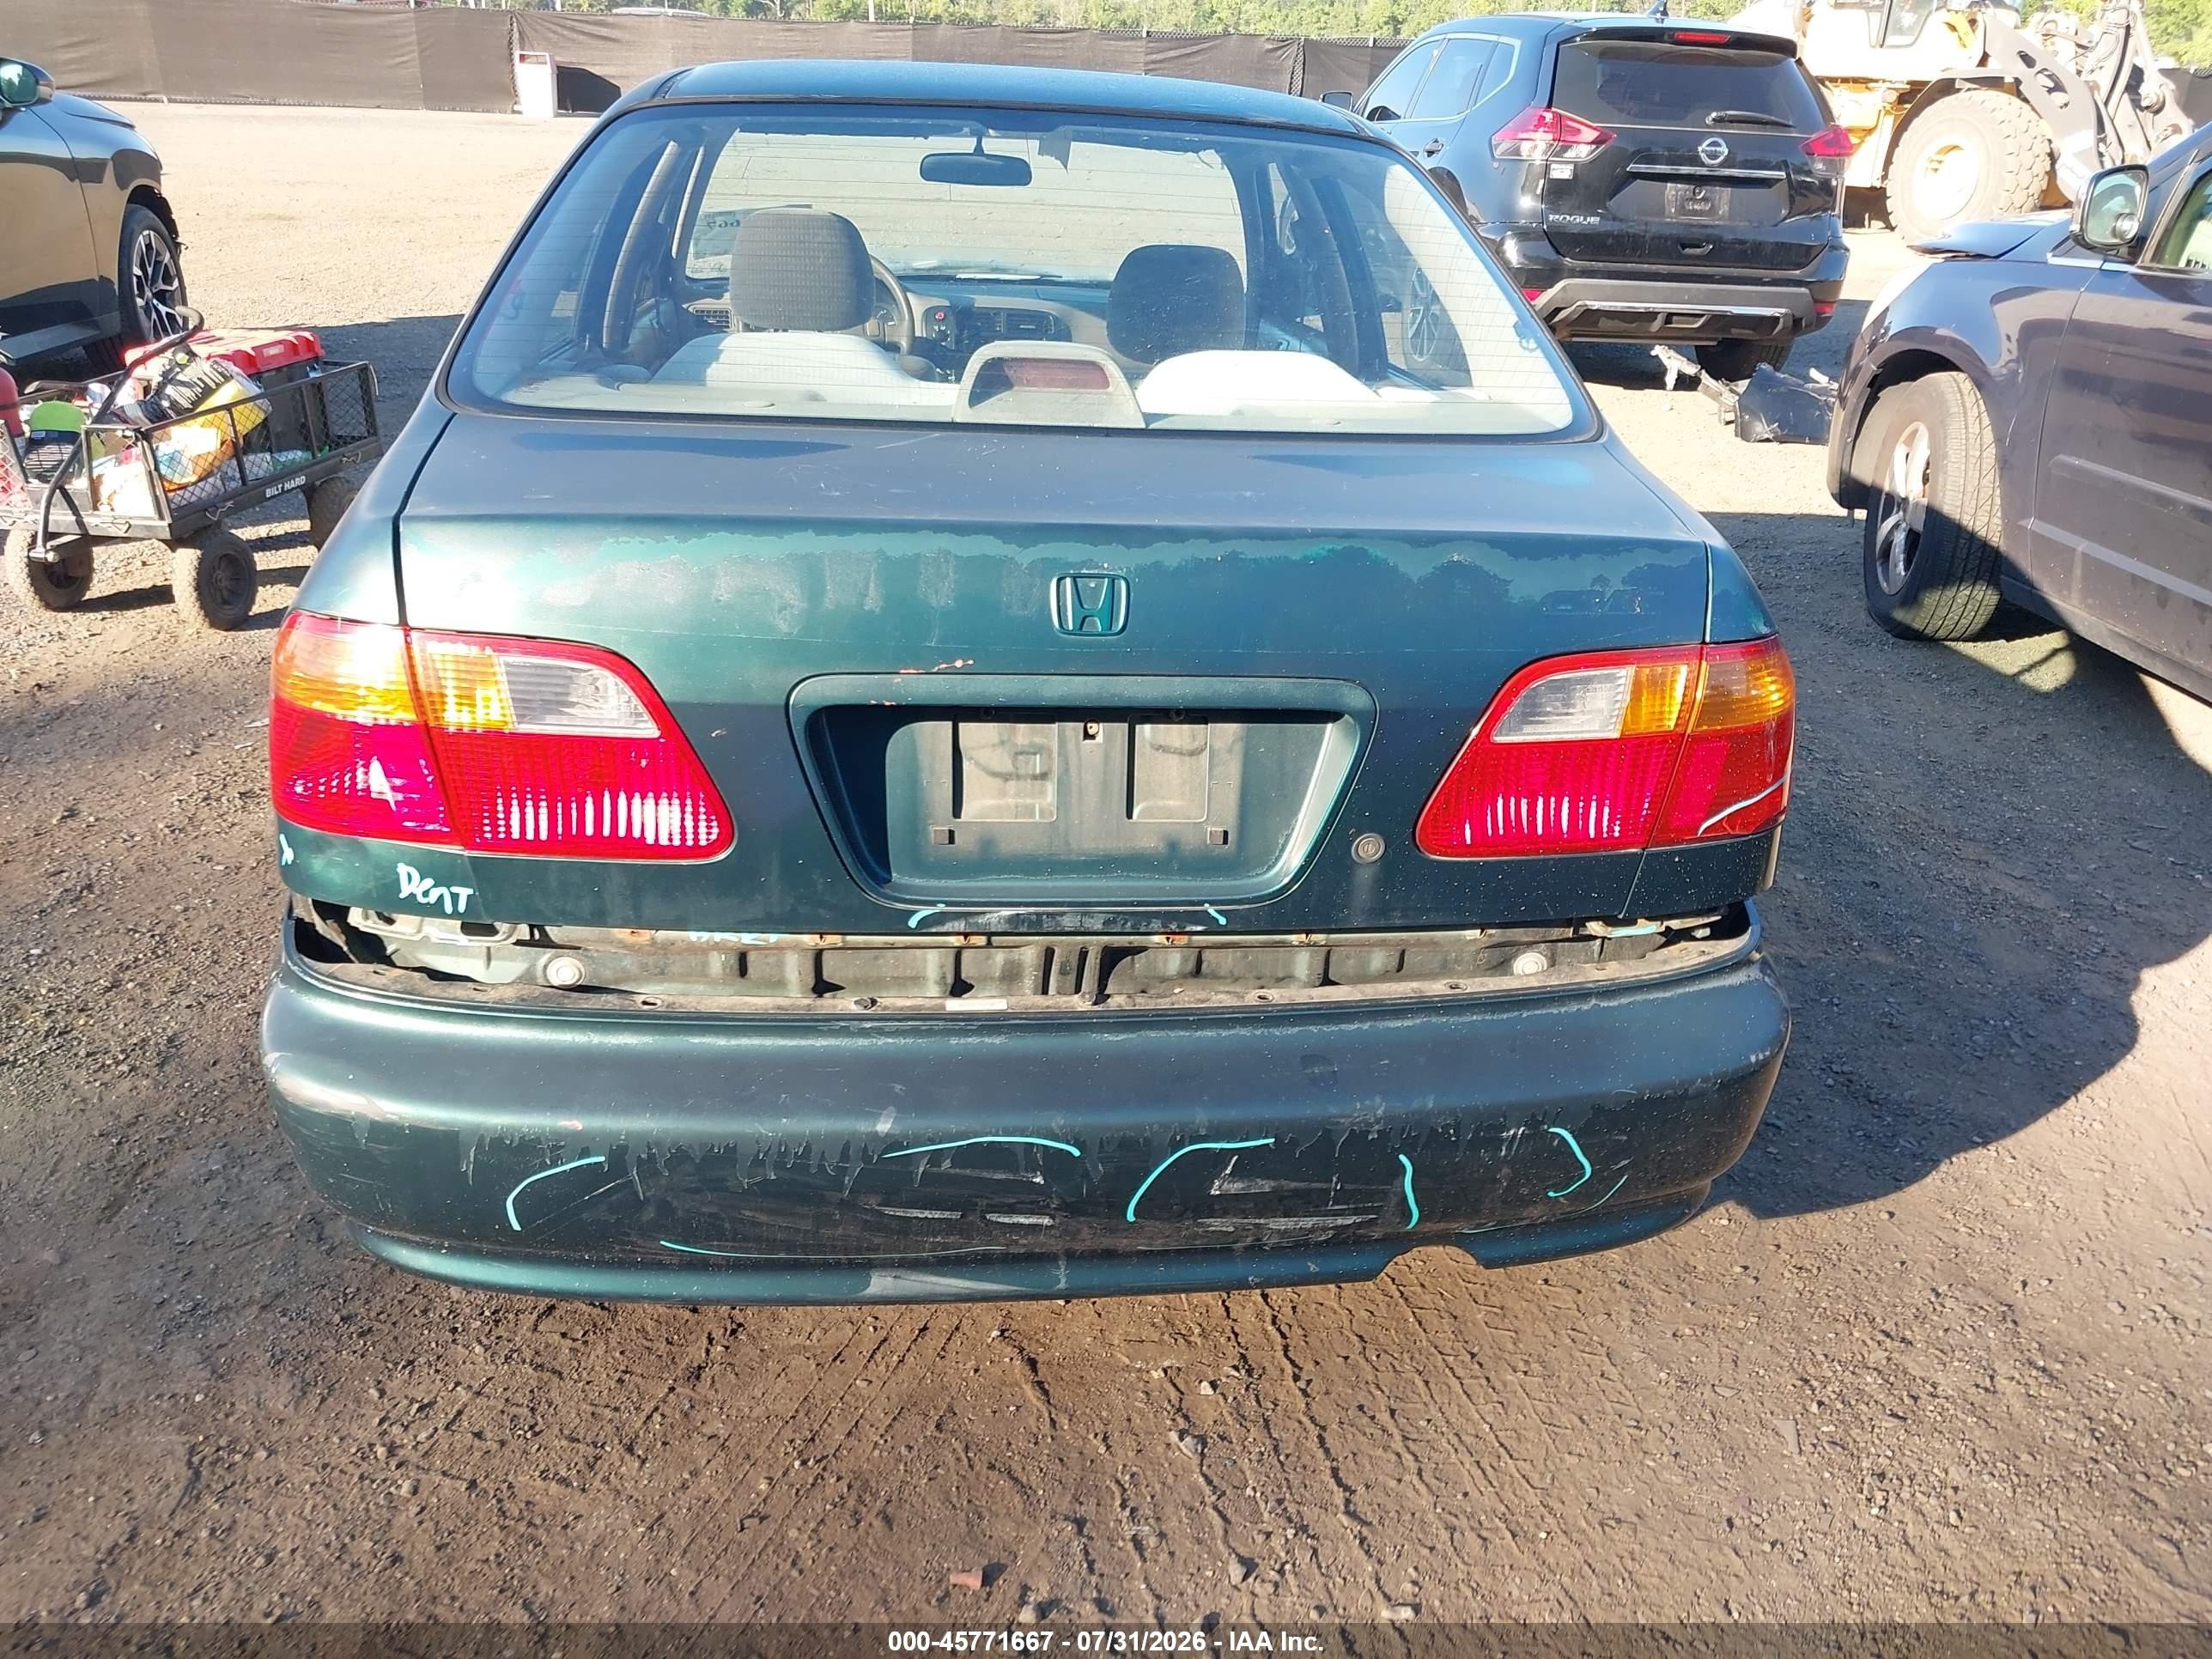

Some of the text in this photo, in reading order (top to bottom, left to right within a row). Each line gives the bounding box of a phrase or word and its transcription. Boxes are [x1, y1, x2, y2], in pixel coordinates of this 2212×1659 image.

[1548, 213, 1601, 225] ROGUE
[265, 475, 307, 498] BILT HARD
